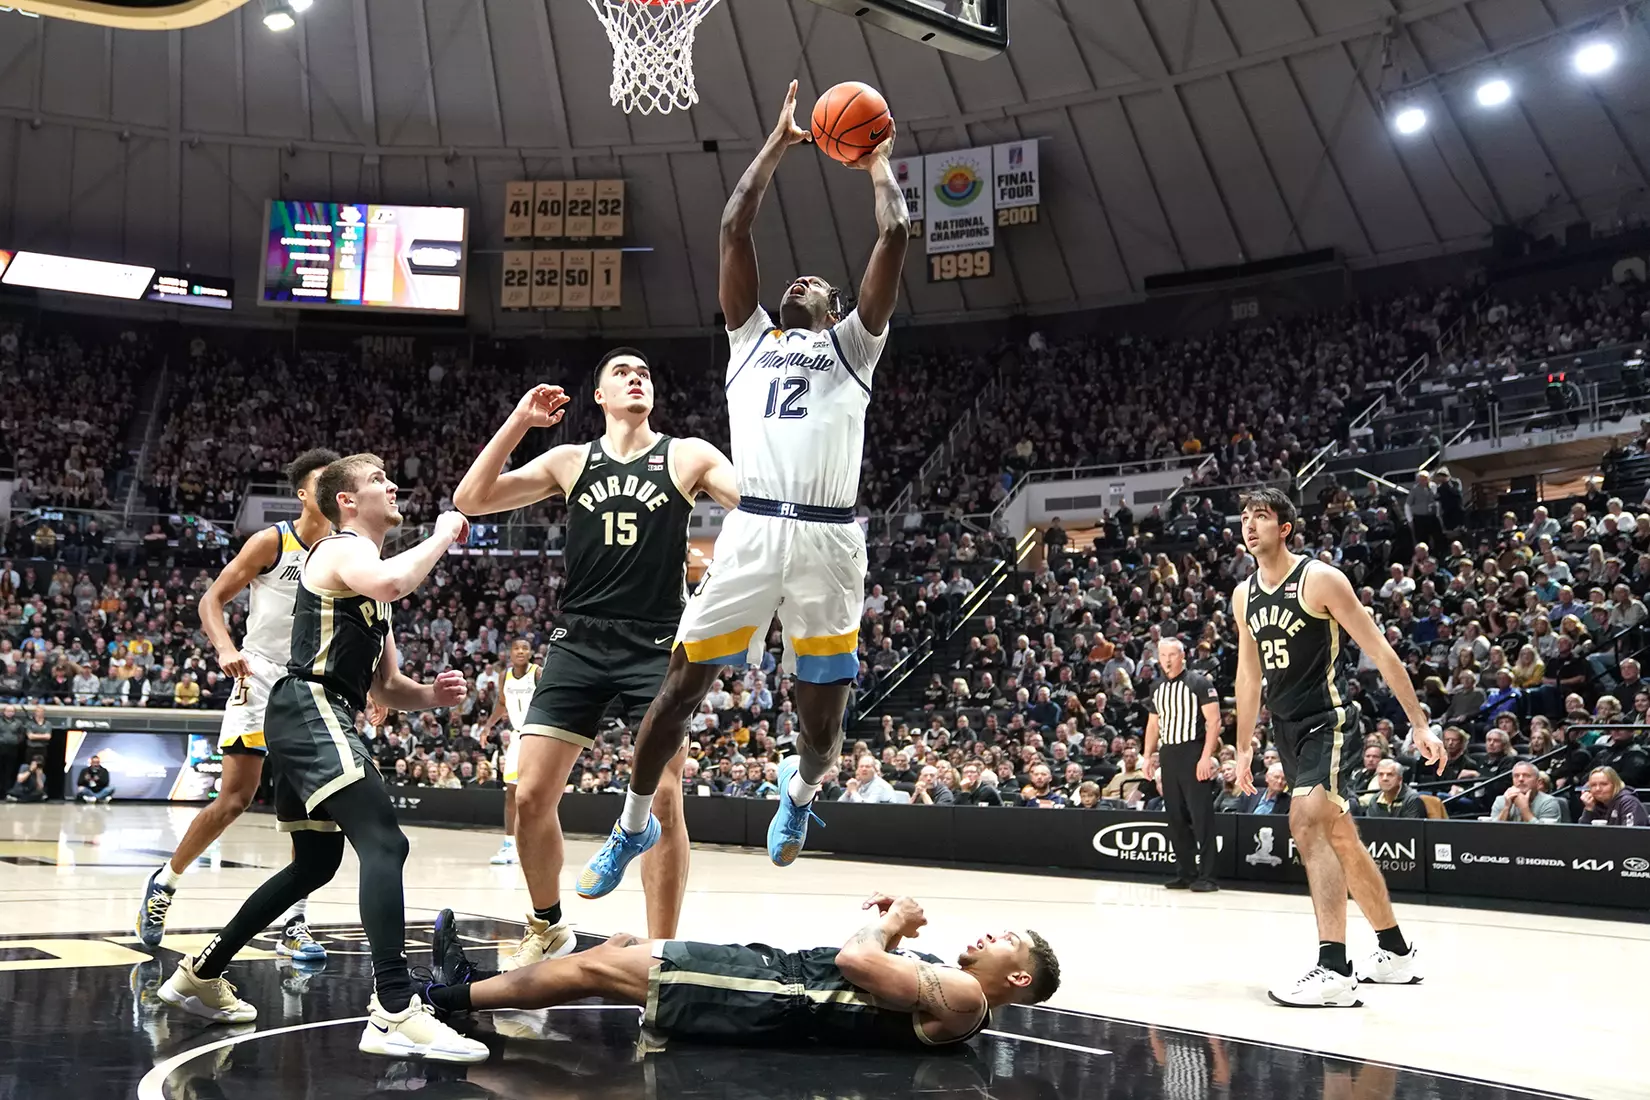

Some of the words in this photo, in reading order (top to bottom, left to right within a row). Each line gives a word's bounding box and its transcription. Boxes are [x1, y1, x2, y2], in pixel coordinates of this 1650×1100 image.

[997, 171, 1036, 188] FINAL
[1000, 185, 1034, 201] FOUR
[509, 200, 530, 217] 41
[537, 199, 562, 217] 40
[568, 199, 592, 217] 22
[598, 198, 621, 216] 32
[997, 205, 1038, 227] 2001
[934, 216, 985, 231] NATIONAL
[930, 226, 990, 243] CHAMPIONS
[931, 251, 991, 281] 1999
[504, 270, 528, 287] 22
[535, 269, 559, 286] 32
[565, 268, 589, 286] 50
[604, 268, 611, 285] 1
[361, 335, 416, 354] PAINT
[754, 349, 835, 375] Mauette
[764, 376, 810, 419] 12
[577, 474, 670, 512] PURDUE
[601, 511, 637, 546] 15
[1248, 604, 1307, 638] URDUE
[1261, 638, 1290, 670] 25
[1120, 850, 1201, 865] HEALTHCE
[1474, 855, 1510, 864] LEXUS
[1525, 858, 1566, 867] HONDA
[1432, 863, 1456, 871] TOYOTA
